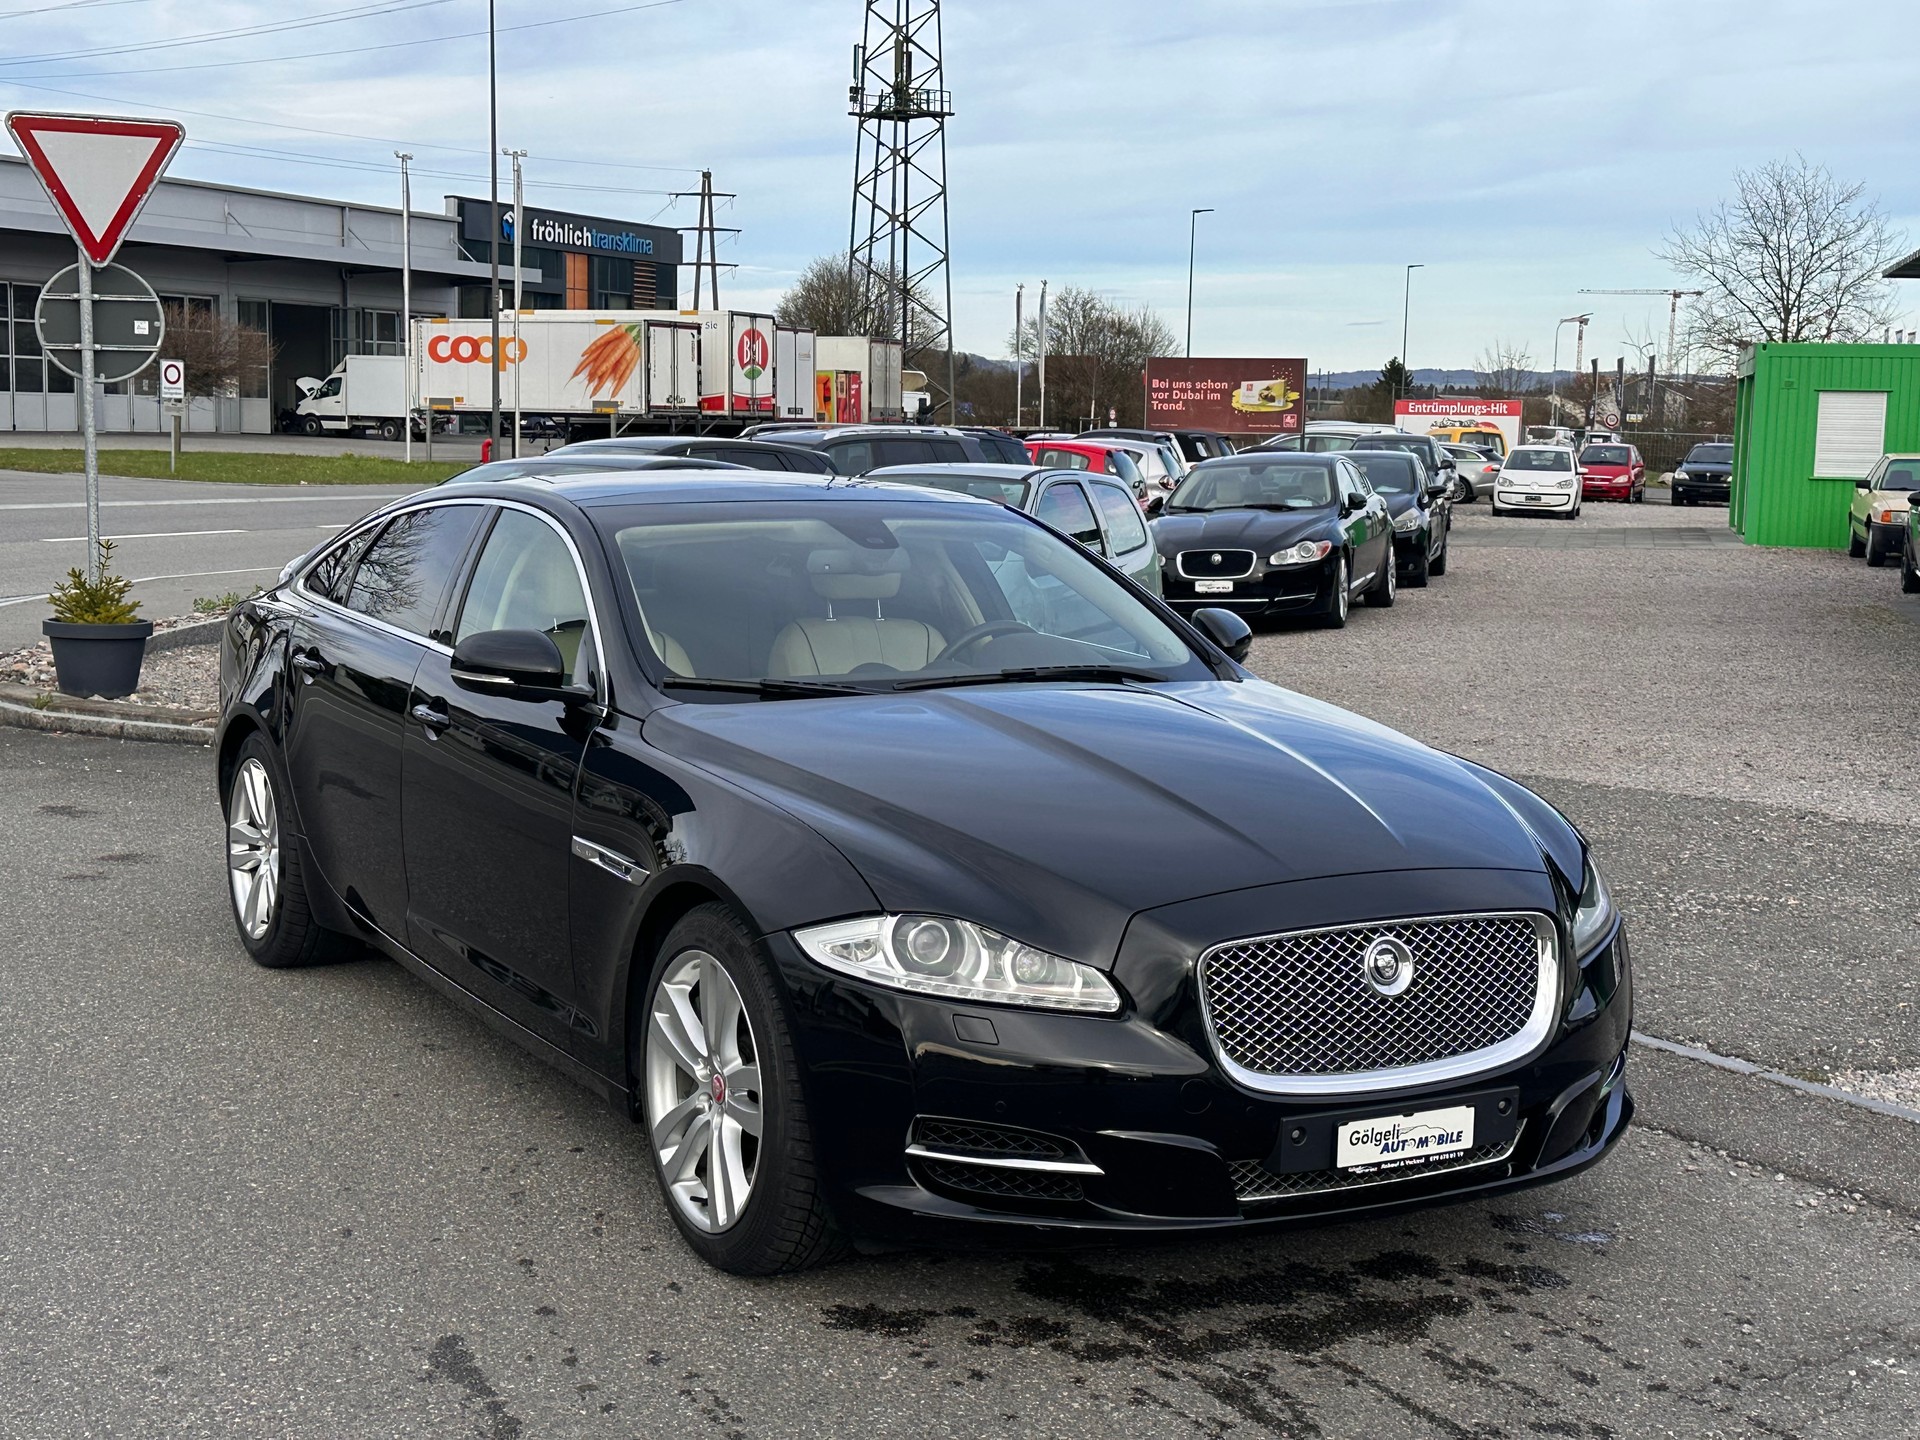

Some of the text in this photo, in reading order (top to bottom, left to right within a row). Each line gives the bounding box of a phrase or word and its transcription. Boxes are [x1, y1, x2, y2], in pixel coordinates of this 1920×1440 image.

[532, 218, 654, 255] fröhlichtransklima
[427, 334, 528, 372] coop
[1152, 378, 1228, 390] Bei uns schon
[1151, 390, 1221, 400] vor Dubai im
[1151, 400, 1186, 411] Trend.
[1408, 402, 1508, 416] Entrümplungs-Hit
[1349, 1123, 1401, 1147] Gölgeli
